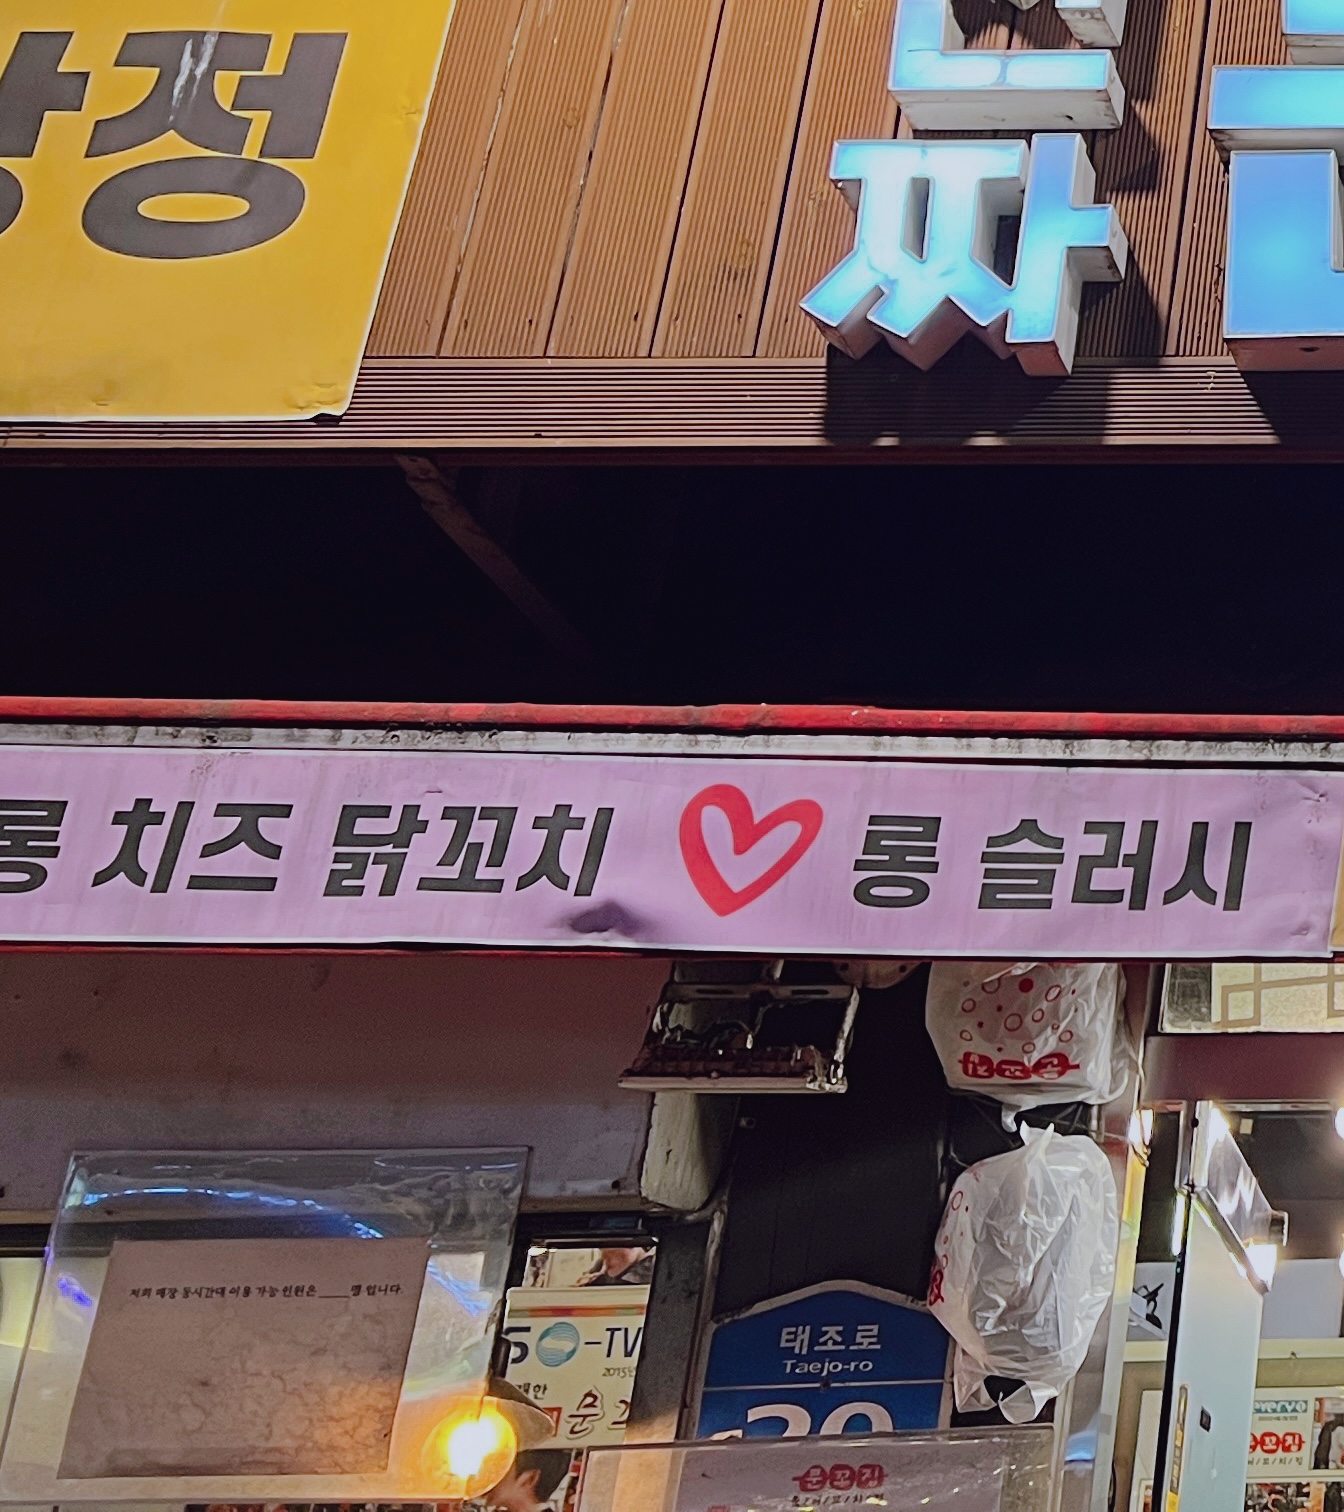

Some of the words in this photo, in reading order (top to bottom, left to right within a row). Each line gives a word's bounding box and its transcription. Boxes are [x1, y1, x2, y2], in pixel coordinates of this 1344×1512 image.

[91, 798, 293, 894] 치즈
[323, 804, 614, 897] 닭꼬치
[853, 815, 941, 908] 롱
[977, 819, 1252, 911] 슬러시
[779, 1324, 881, 1355] 태조로
[783, 1358, 873, 1377] Taejo-ro
